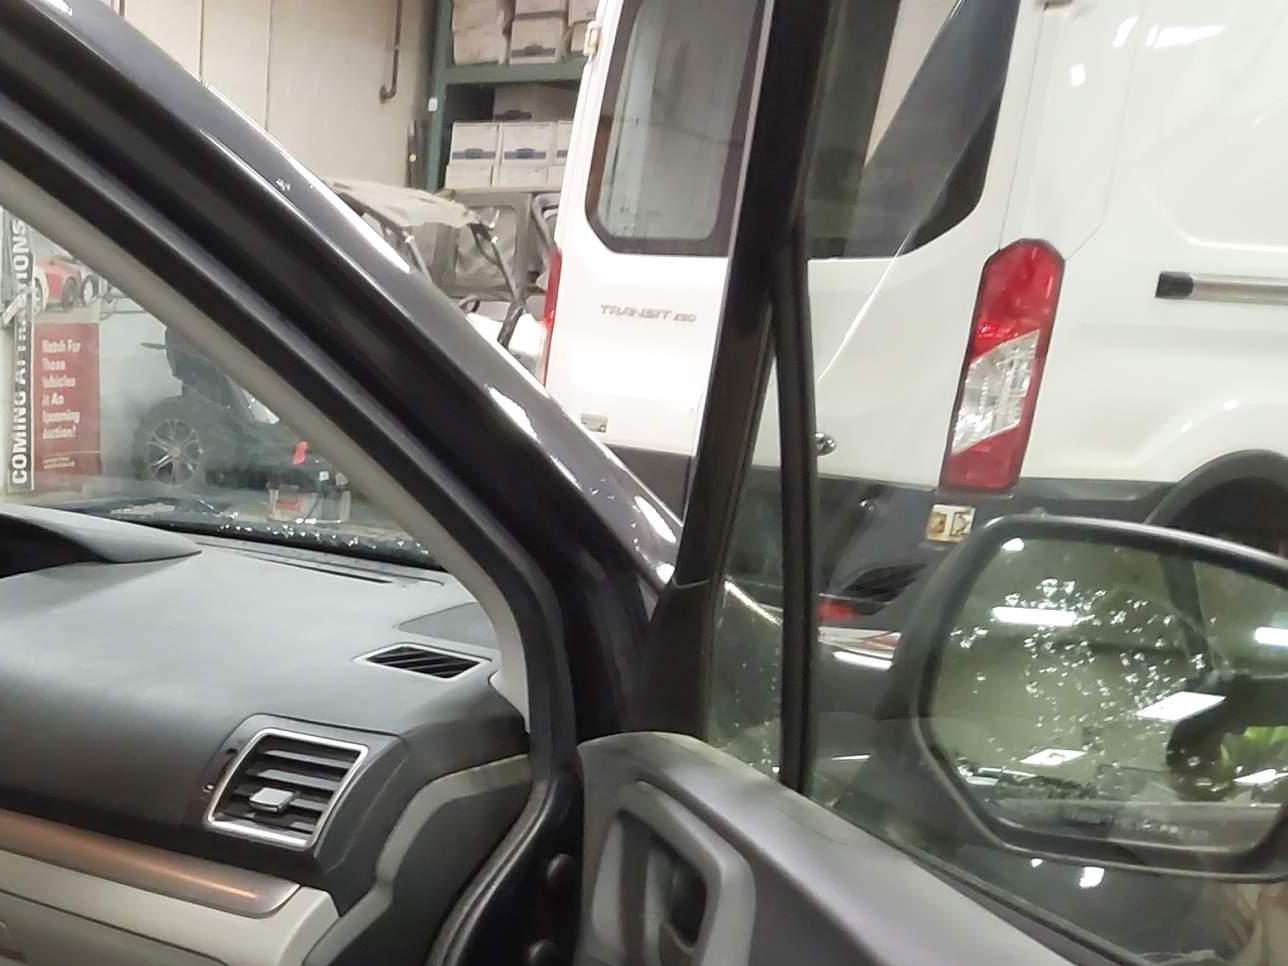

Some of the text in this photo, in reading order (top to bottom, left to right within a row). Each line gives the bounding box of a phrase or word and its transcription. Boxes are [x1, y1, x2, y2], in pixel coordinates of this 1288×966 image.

[599, 304, 673, 320] TRANSIT
[67, 339, 81, 353] For
[12, 391, 28, 484] COMING
